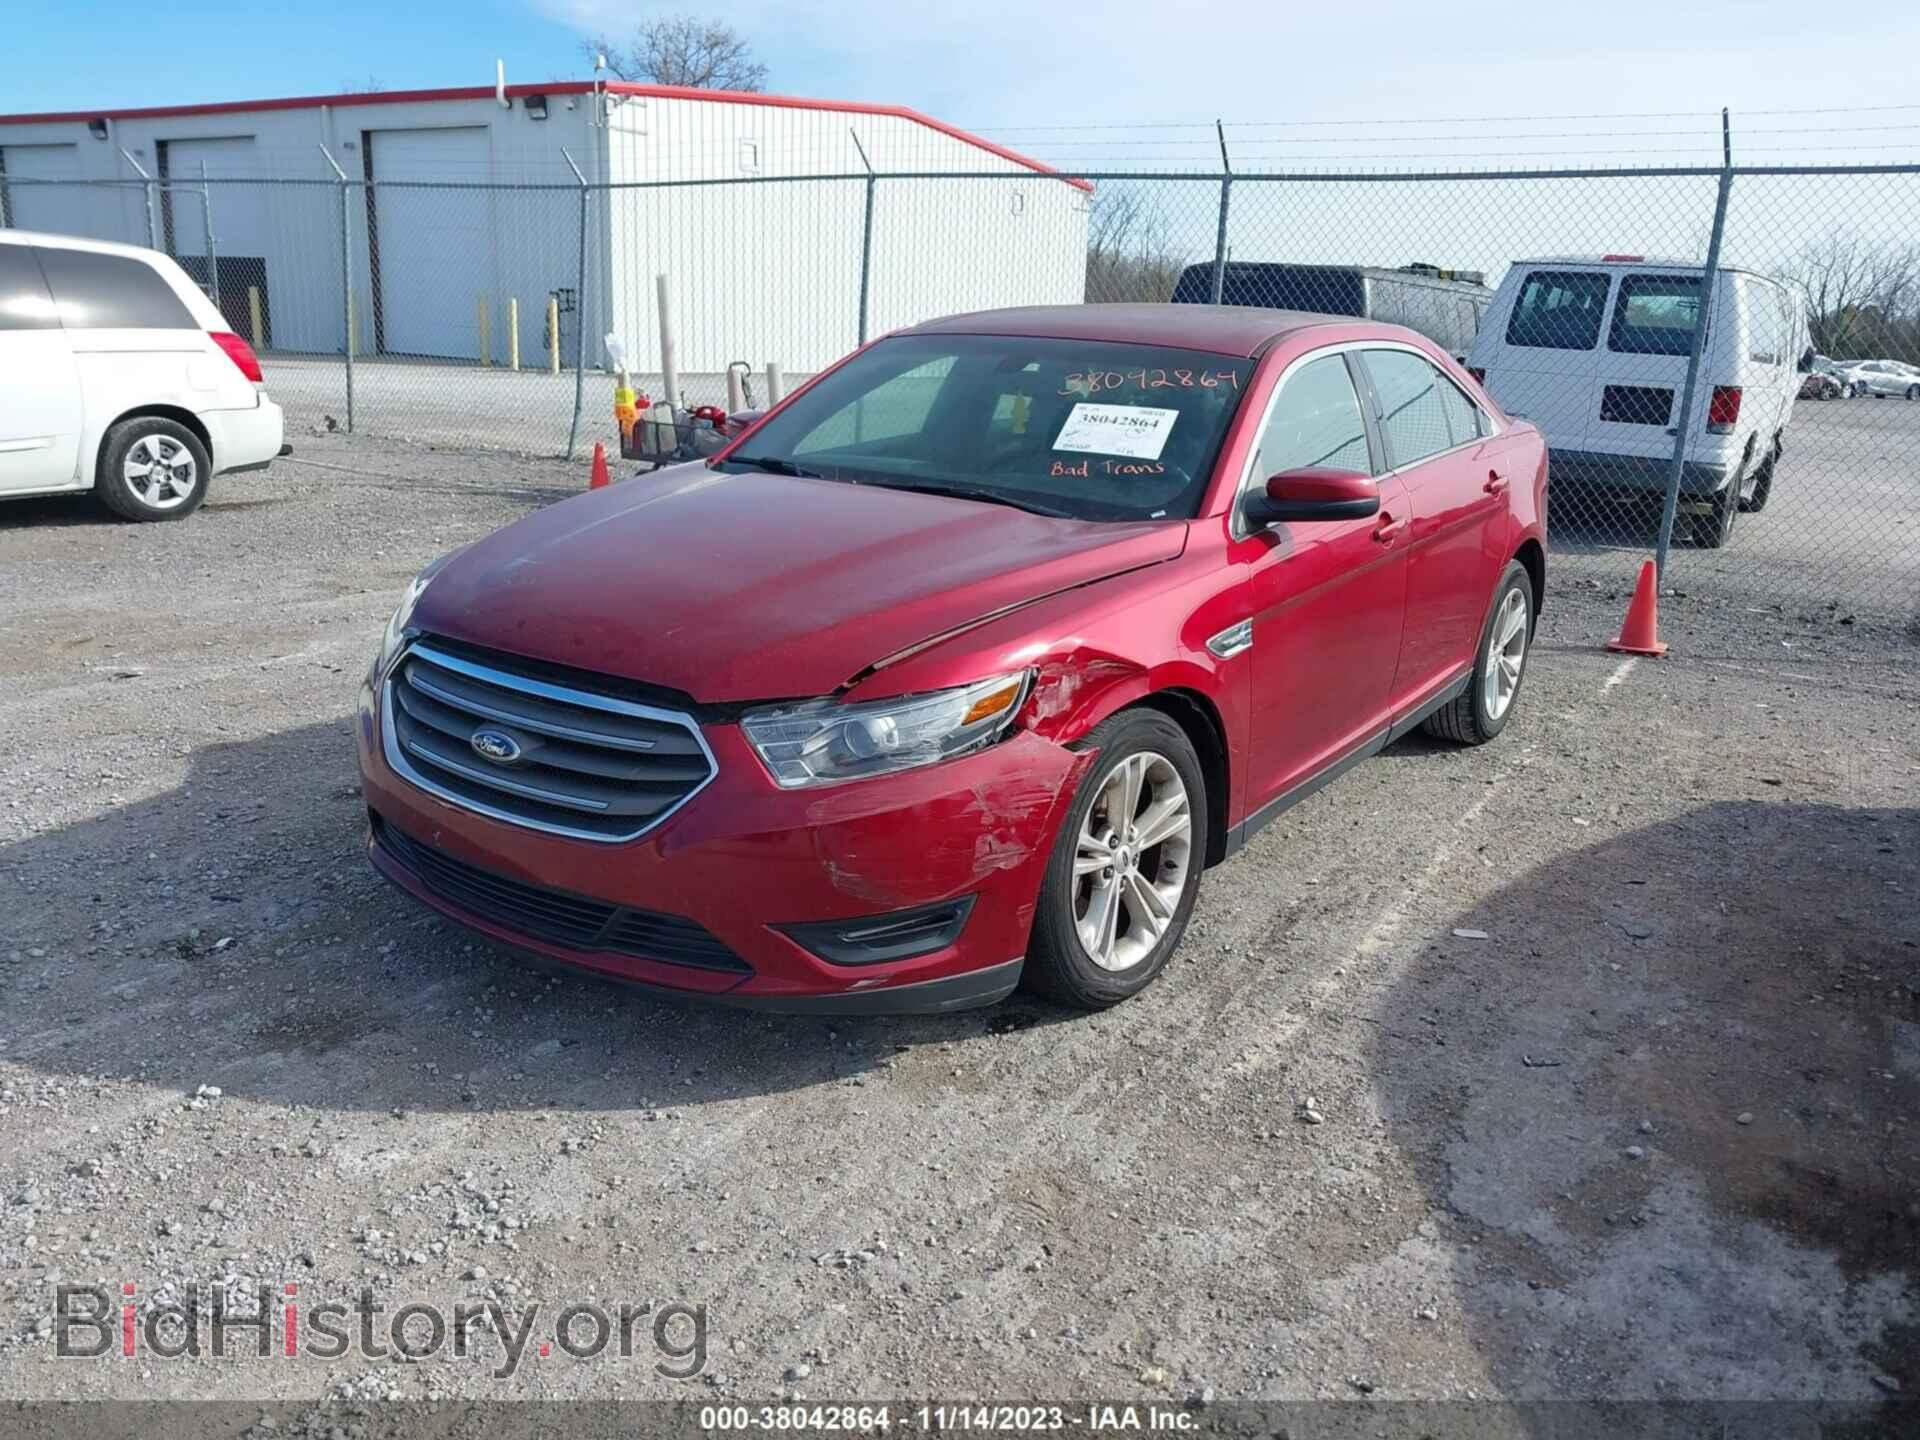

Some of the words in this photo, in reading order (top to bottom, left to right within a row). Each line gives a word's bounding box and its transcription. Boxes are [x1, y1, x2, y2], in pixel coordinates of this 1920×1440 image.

[1057, 369, 1239, 396] 38042864
[1082, 414, 1160, 429] 38042864
[1050, 461, 1089, 477] Bad
[1104, 460, 1165, 475] Trans
[480, 735, 507, 756] Ford
